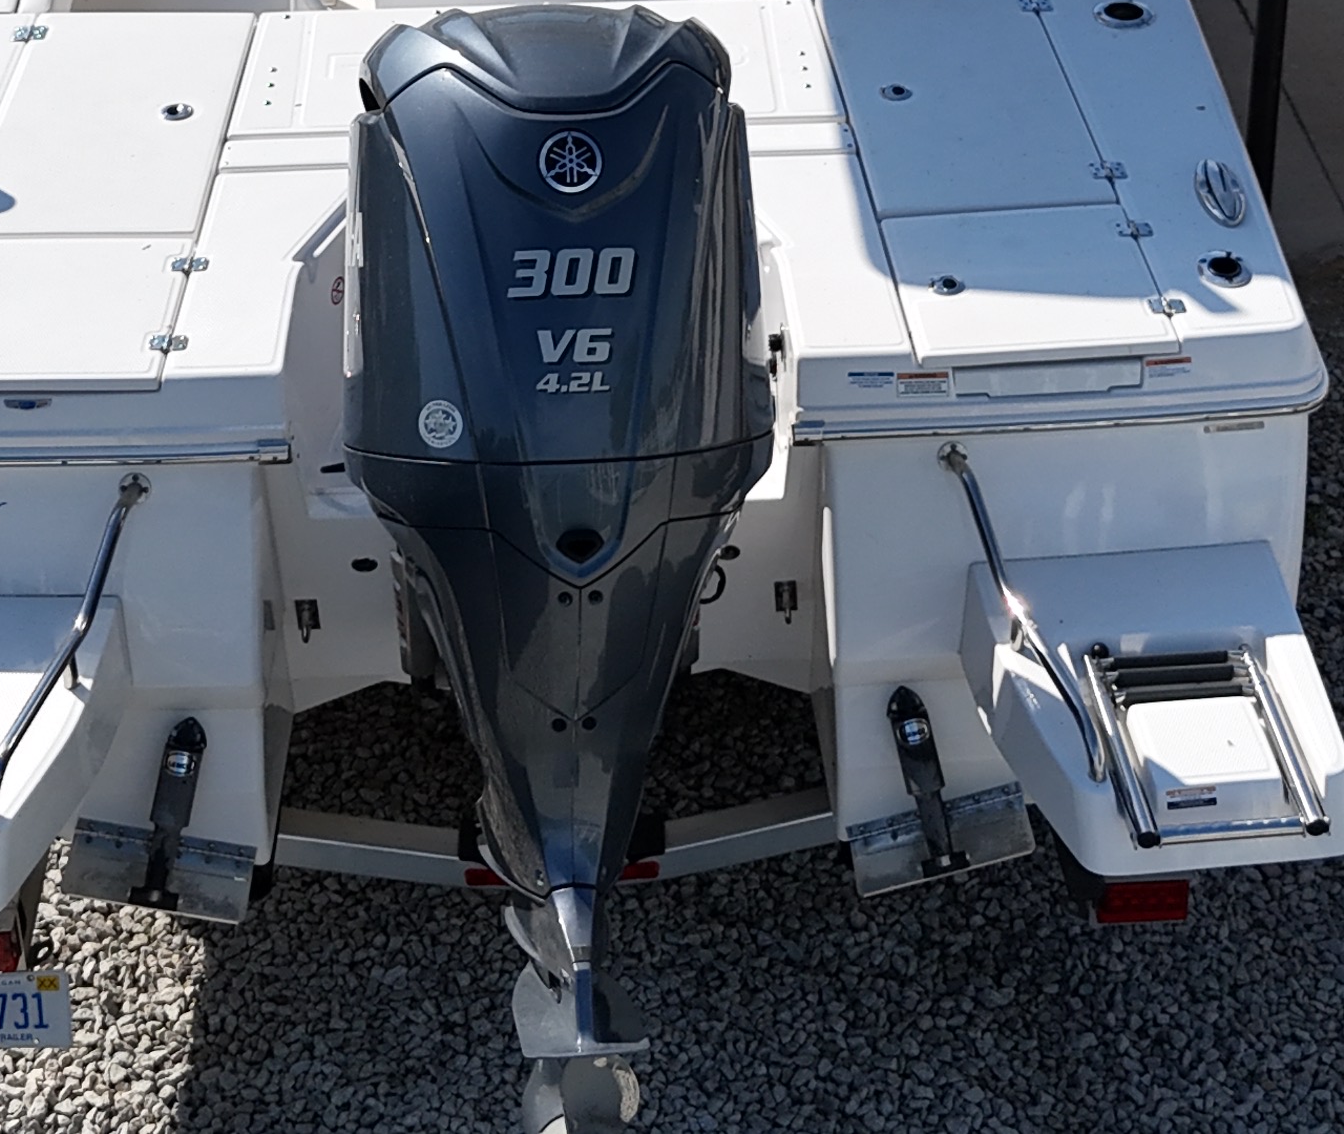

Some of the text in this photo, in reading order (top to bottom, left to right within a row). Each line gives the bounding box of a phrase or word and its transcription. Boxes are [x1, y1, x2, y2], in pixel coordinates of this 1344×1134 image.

[507, 247, 636, 298] 300
[536, 327, 613, 363] V6
[535, 371, 611, 393] 4.2L
[37, 978, 57, 988] XX
